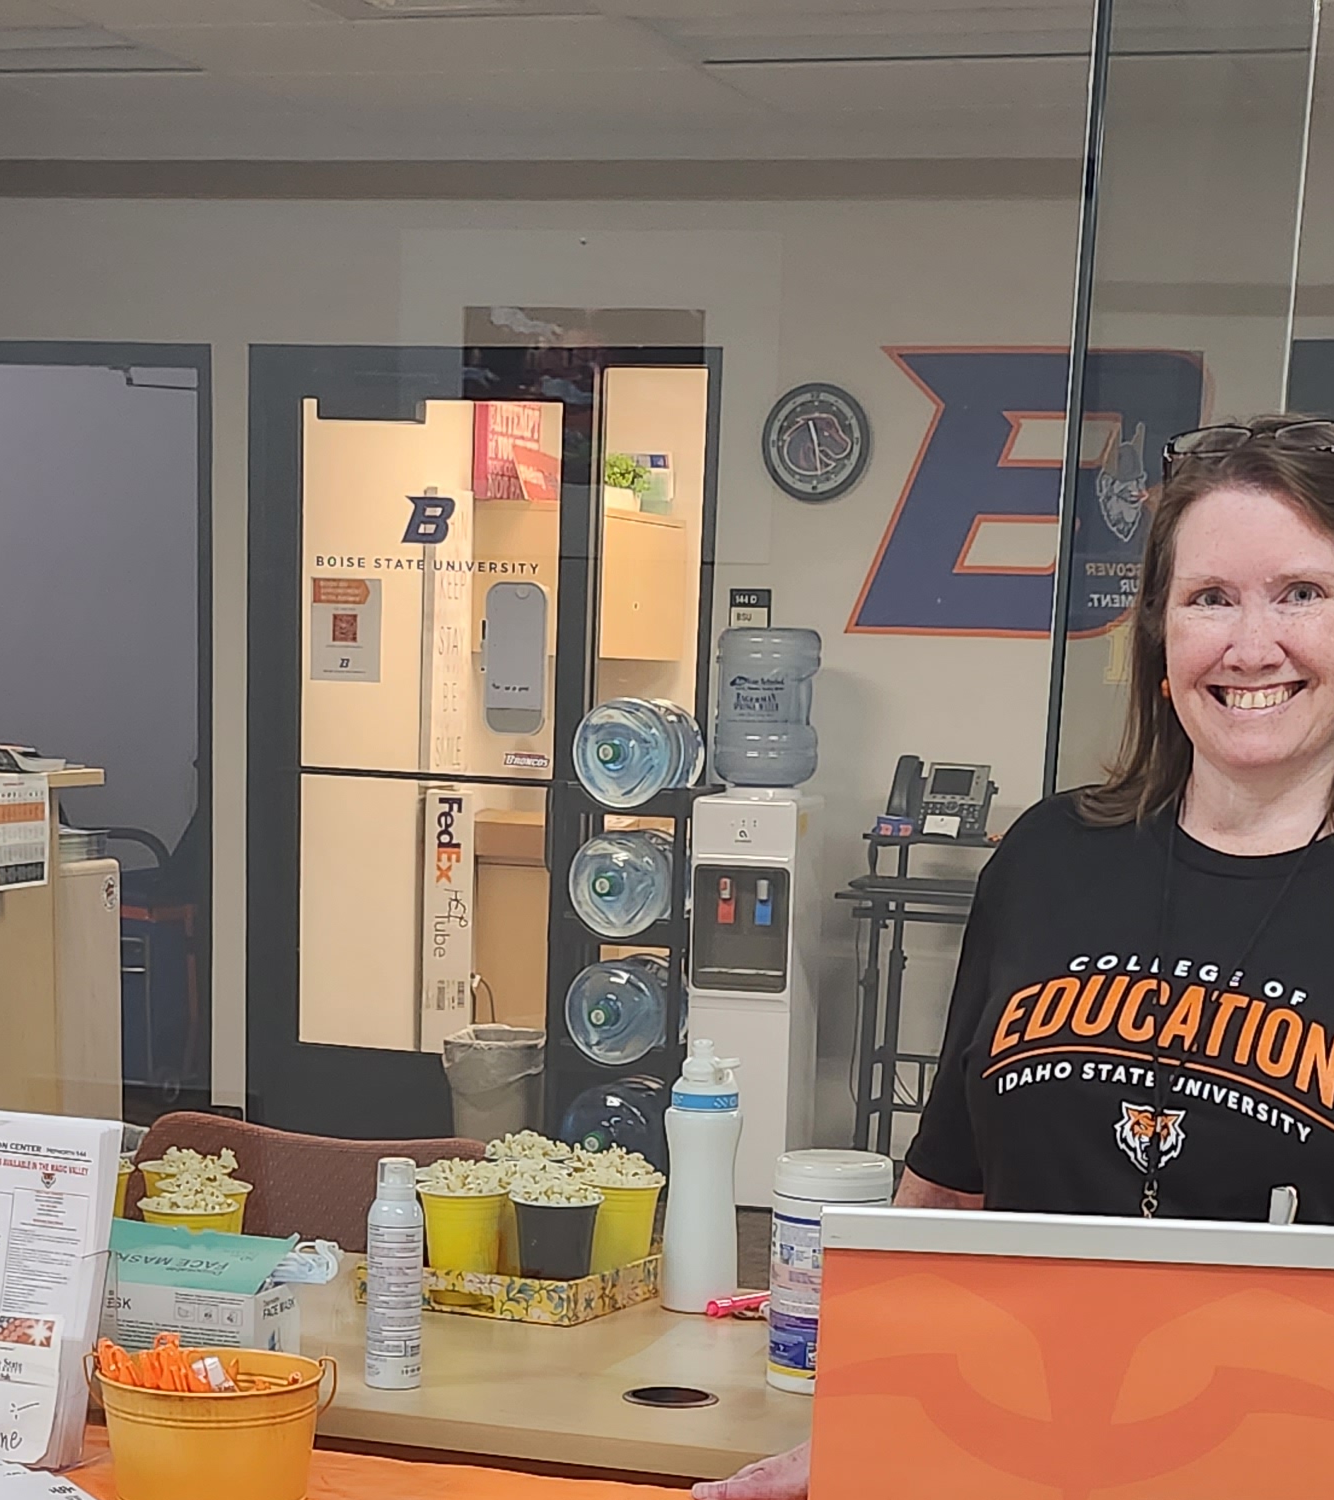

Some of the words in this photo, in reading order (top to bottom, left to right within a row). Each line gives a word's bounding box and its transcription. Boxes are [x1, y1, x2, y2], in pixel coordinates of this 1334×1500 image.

[400, 494, 456, 545] B
[315, 555, 367, 570] BOISE
[373, 558, 429, 573] STATE
[433, 560, 540, 576] UNIVERSITY
[441, 571, 467, 600] KEEP
[438, 626, 466, 656] STAY
[442, 683, 458, 713] BE
[506, 755, 549, 768] BRONCOS
[435, 797, 464, 885] FedEx
[434, 914, 452, 958] Tube
[1068, 954, 1245, 988] COLLEGE
[1263, 979, 1308, 1006] OF
[997, 1061, 1073, 1095] IDAHO
[1081, 1061, 1156, 1088] STATE
[1170, 1074, 1313, 1144] UNIVERSITY
[9, 1142, 42, 1153] CENTER
[38, 1161, 49, 1171] THE
[176, 1258, 230, 1271] FACE
